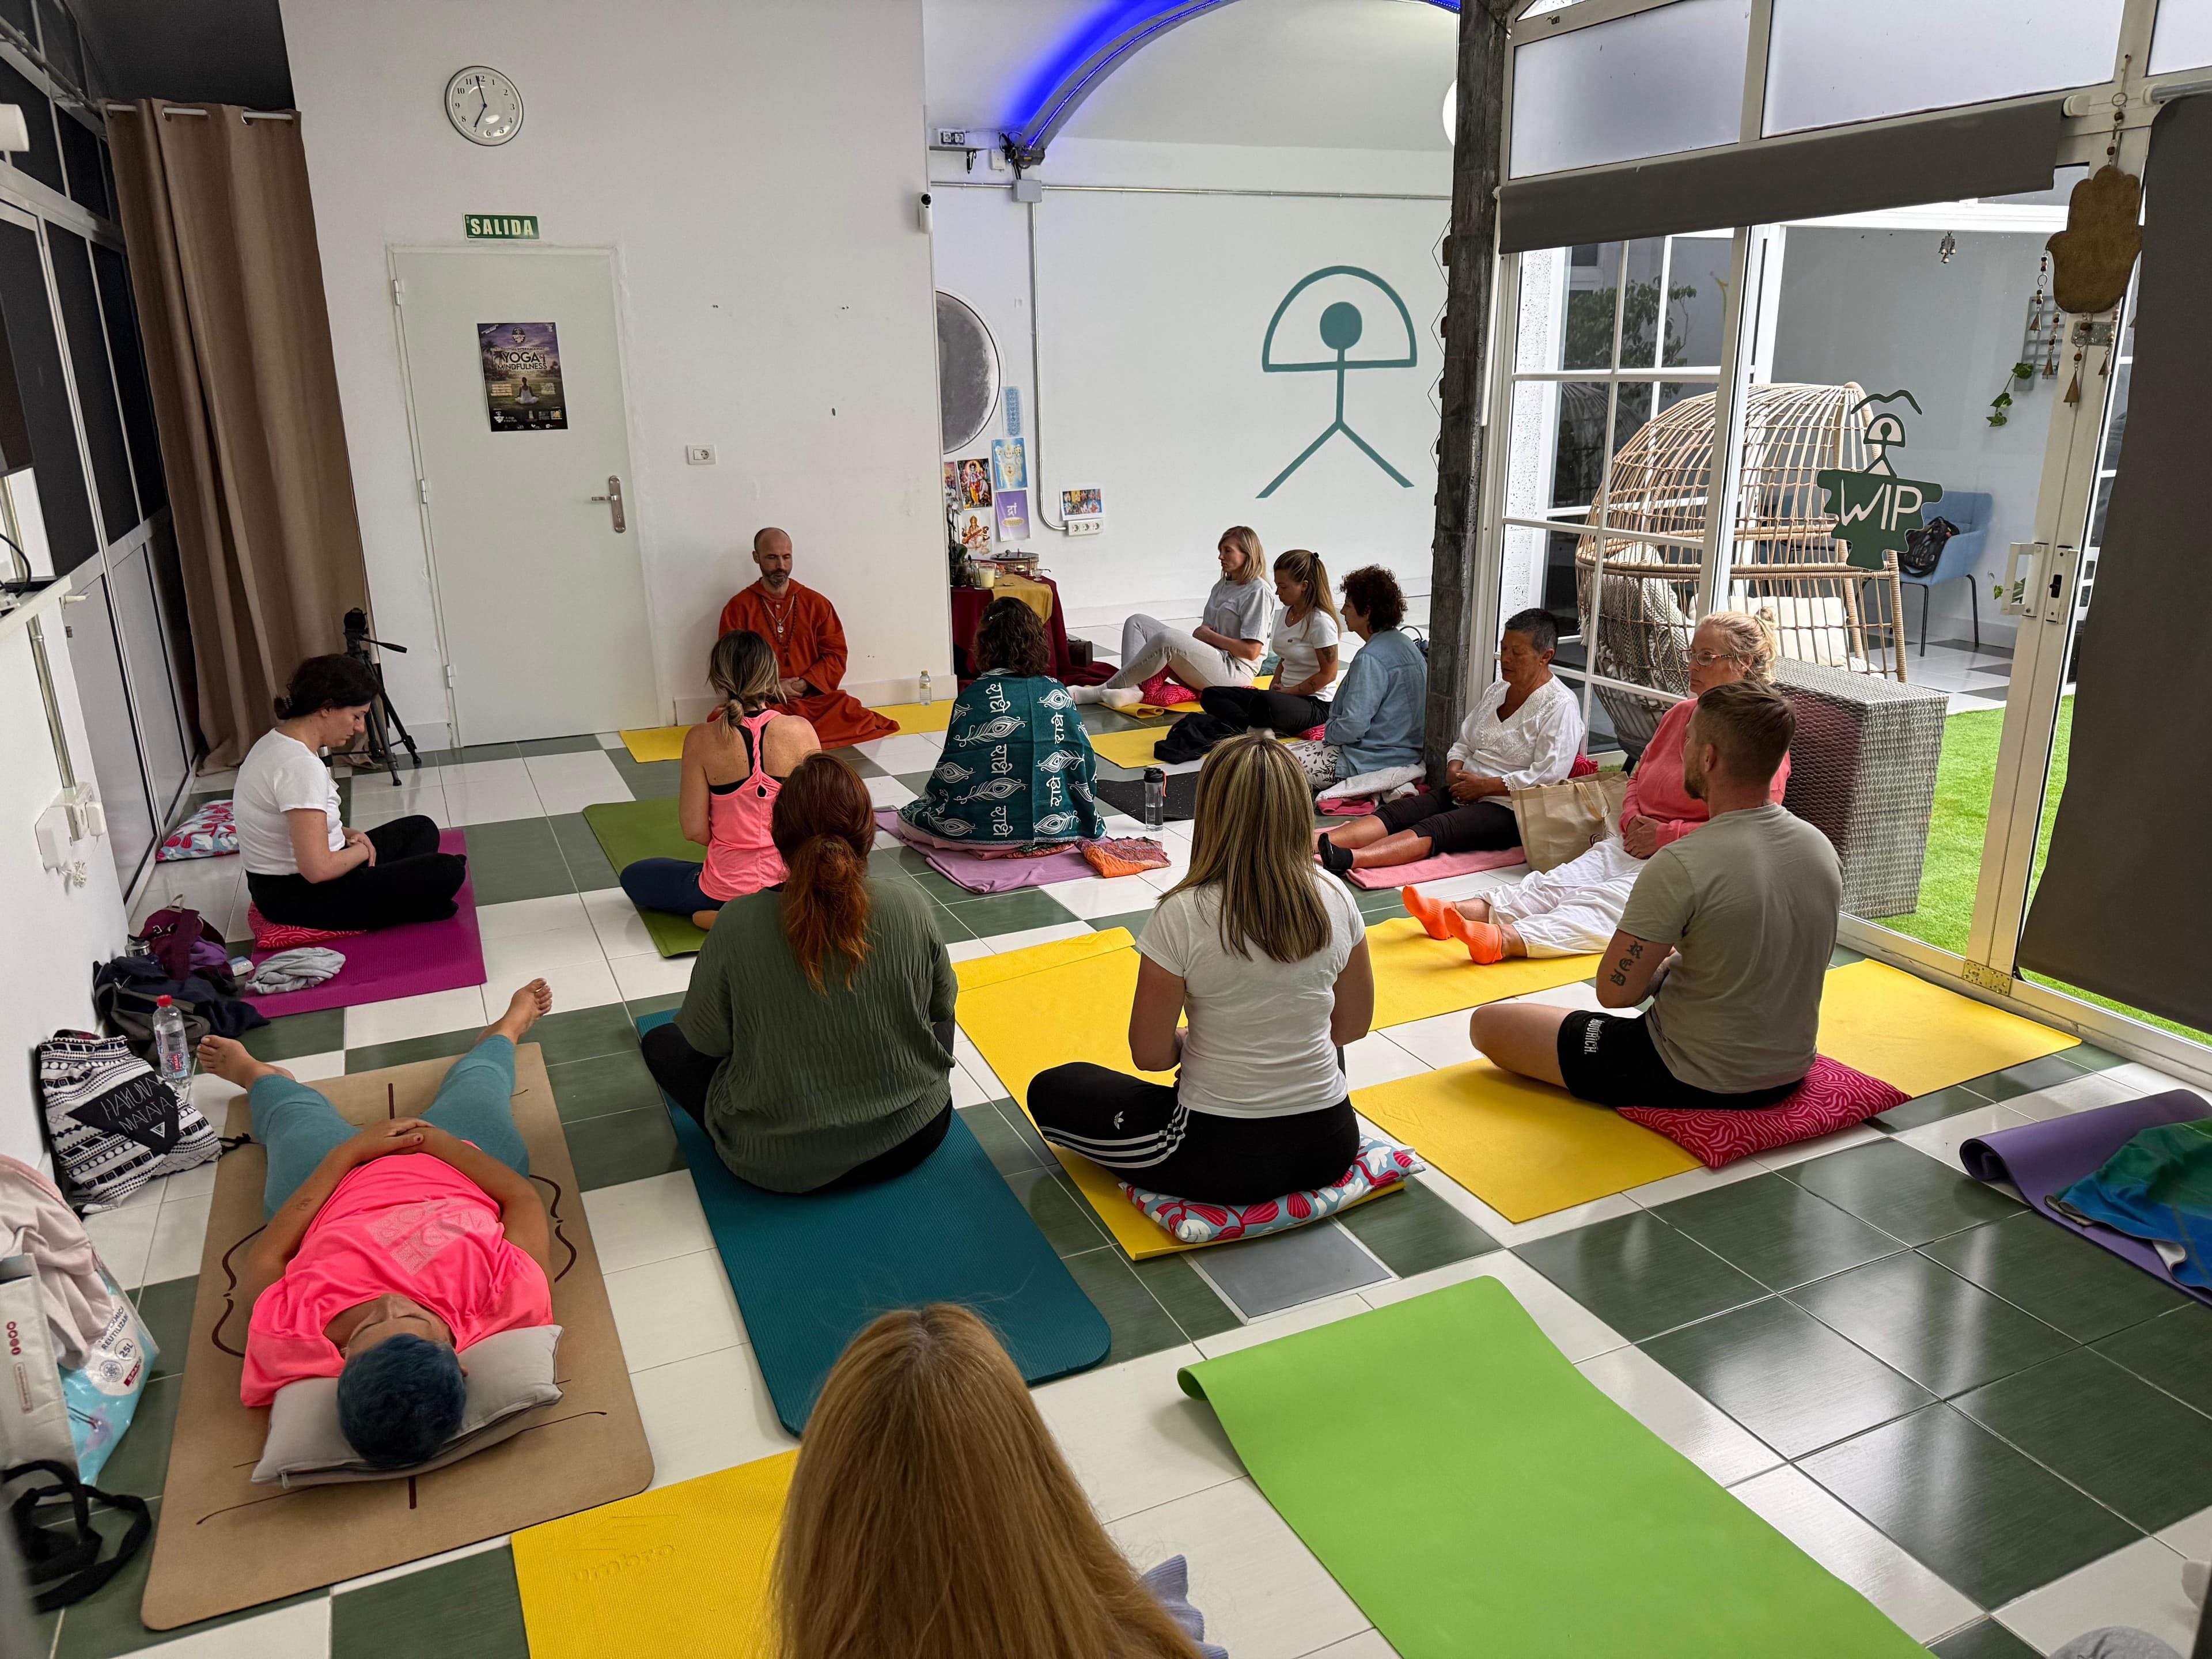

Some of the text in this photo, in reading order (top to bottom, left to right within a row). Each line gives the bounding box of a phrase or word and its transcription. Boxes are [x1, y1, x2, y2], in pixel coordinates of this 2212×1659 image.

[470, 218, 533, 236] SALIDA
[502, 351, 540, 363] YOGA
[1841, 479, 1923, 531] WIP
[100, 1077, 160, 1121] HAKUNA
[118, 1096, 174, 1134] MATATA
[119, 1343, 134, 1358] 25L
